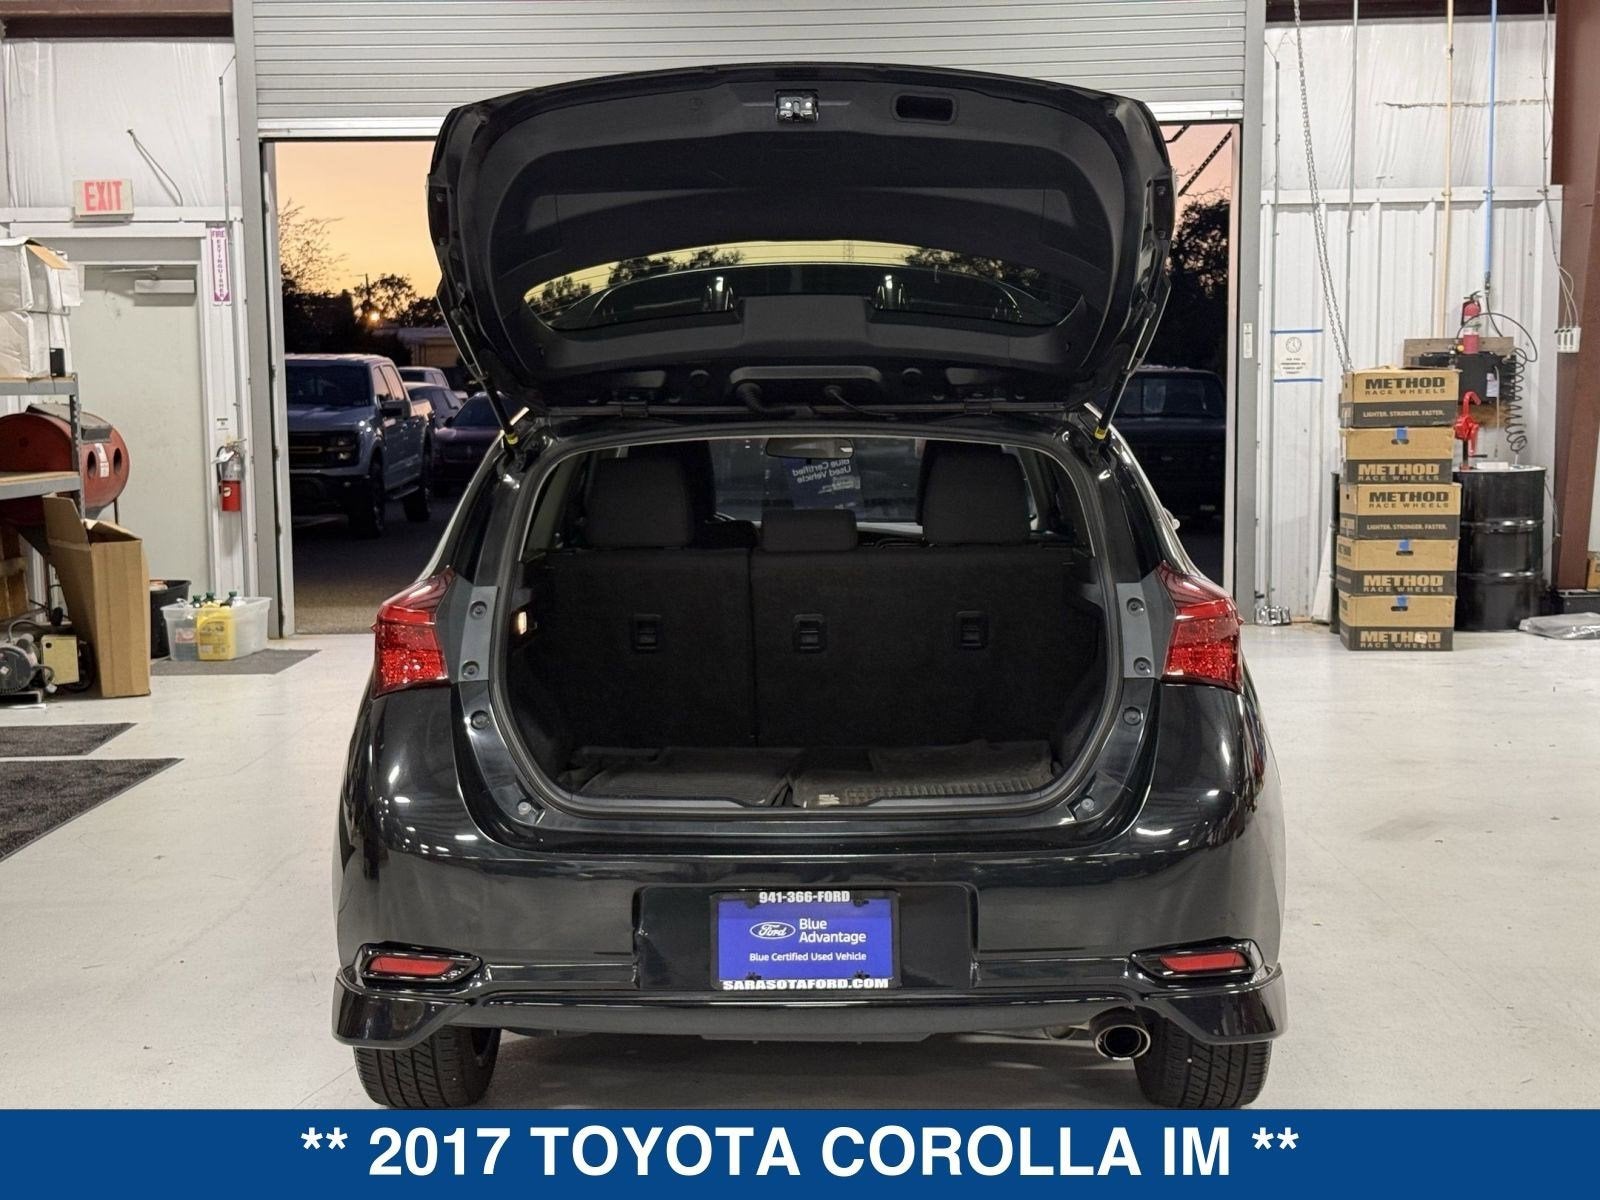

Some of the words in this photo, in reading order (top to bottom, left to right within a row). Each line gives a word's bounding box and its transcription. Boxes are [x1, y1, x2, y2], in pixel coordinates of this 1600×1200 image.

[84, 181, 122, 211] EXIT
[211, 230, 225, 238] FIRE
[1365, 377, 1445, 389] METHOD
[1358, 463, 1440, 476] METHOD
[1369, 491, 1449, 503] METHOD
[1363, 575, 1444, 587] METHOD
[759, 891, 850, 903] 941-366-FORD
[758, 924, 787, 937] Ford
[799, 919, 828, 930] Blue
[799, 931, 867, 945] Advantage
[749, 953, 769, 962] Blue
[771, 952, 809, 962] Certified
[810, 952, 833, 961] Used
[836, 952, 867, 961] Vehicle
[723, 979, 889, 990] SARASOTAFORD.COM
